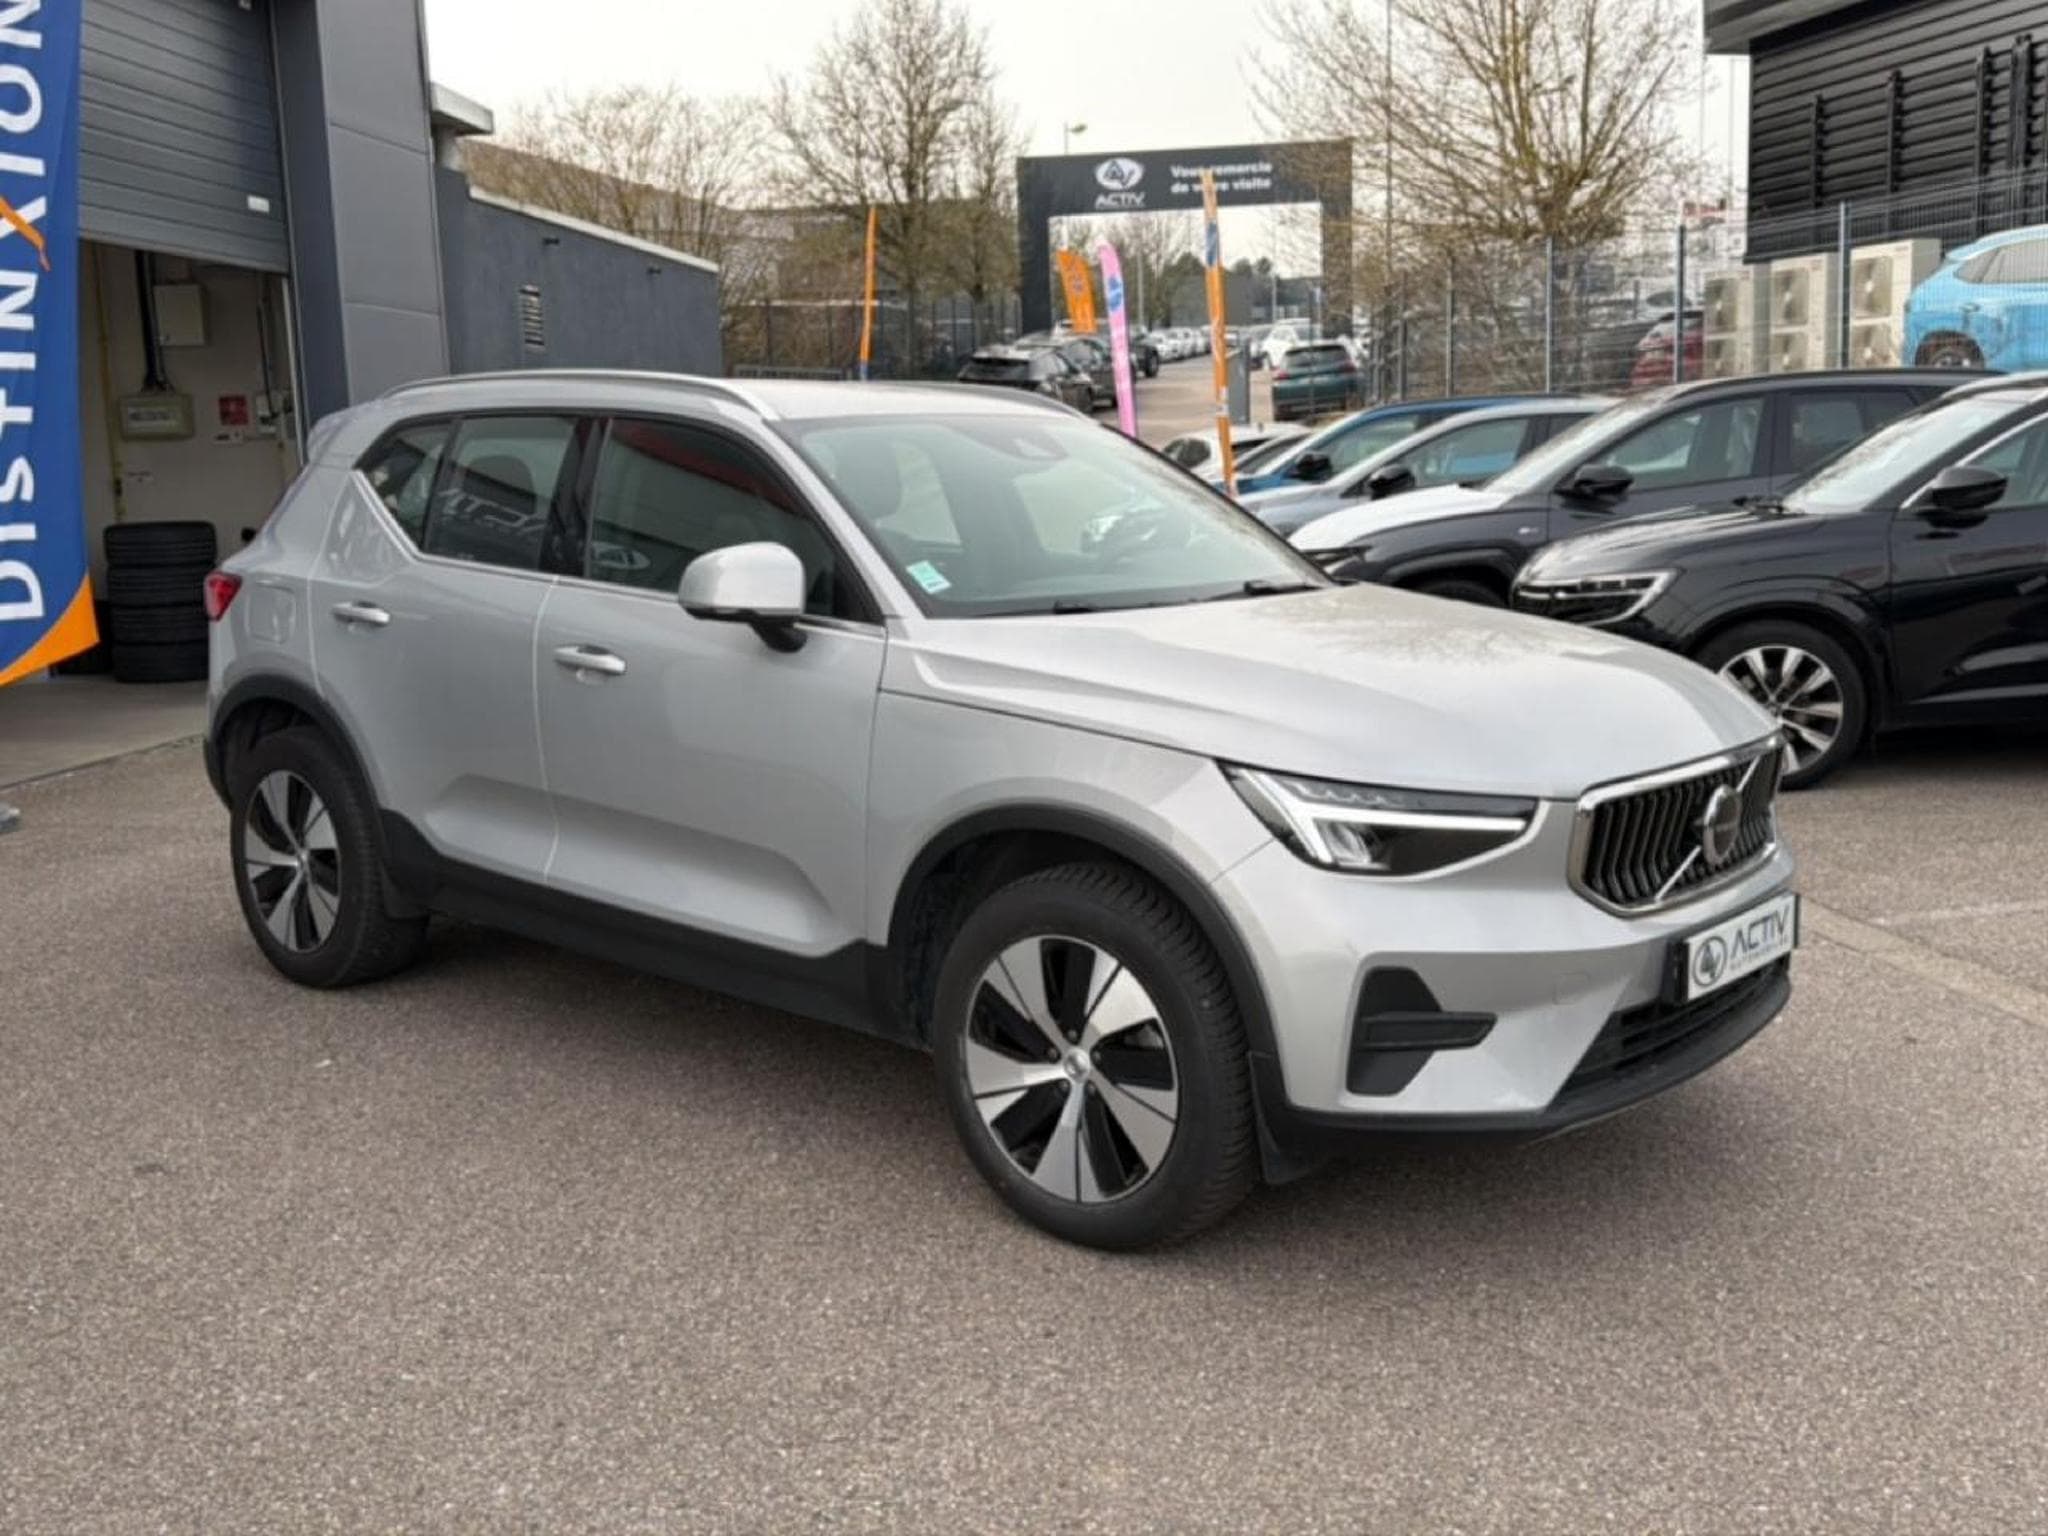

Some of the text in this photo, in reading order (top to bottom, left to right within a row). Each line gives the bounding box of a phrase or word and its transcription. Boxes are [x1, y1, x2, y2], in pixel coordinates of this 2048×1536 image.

[1171, 182, 1189, 193] de
[1232, 177, 1272, 190] visite
[1095, 191, 1145, 208] ACTIV
[1731, 905, 1789, 958] ACTIV
